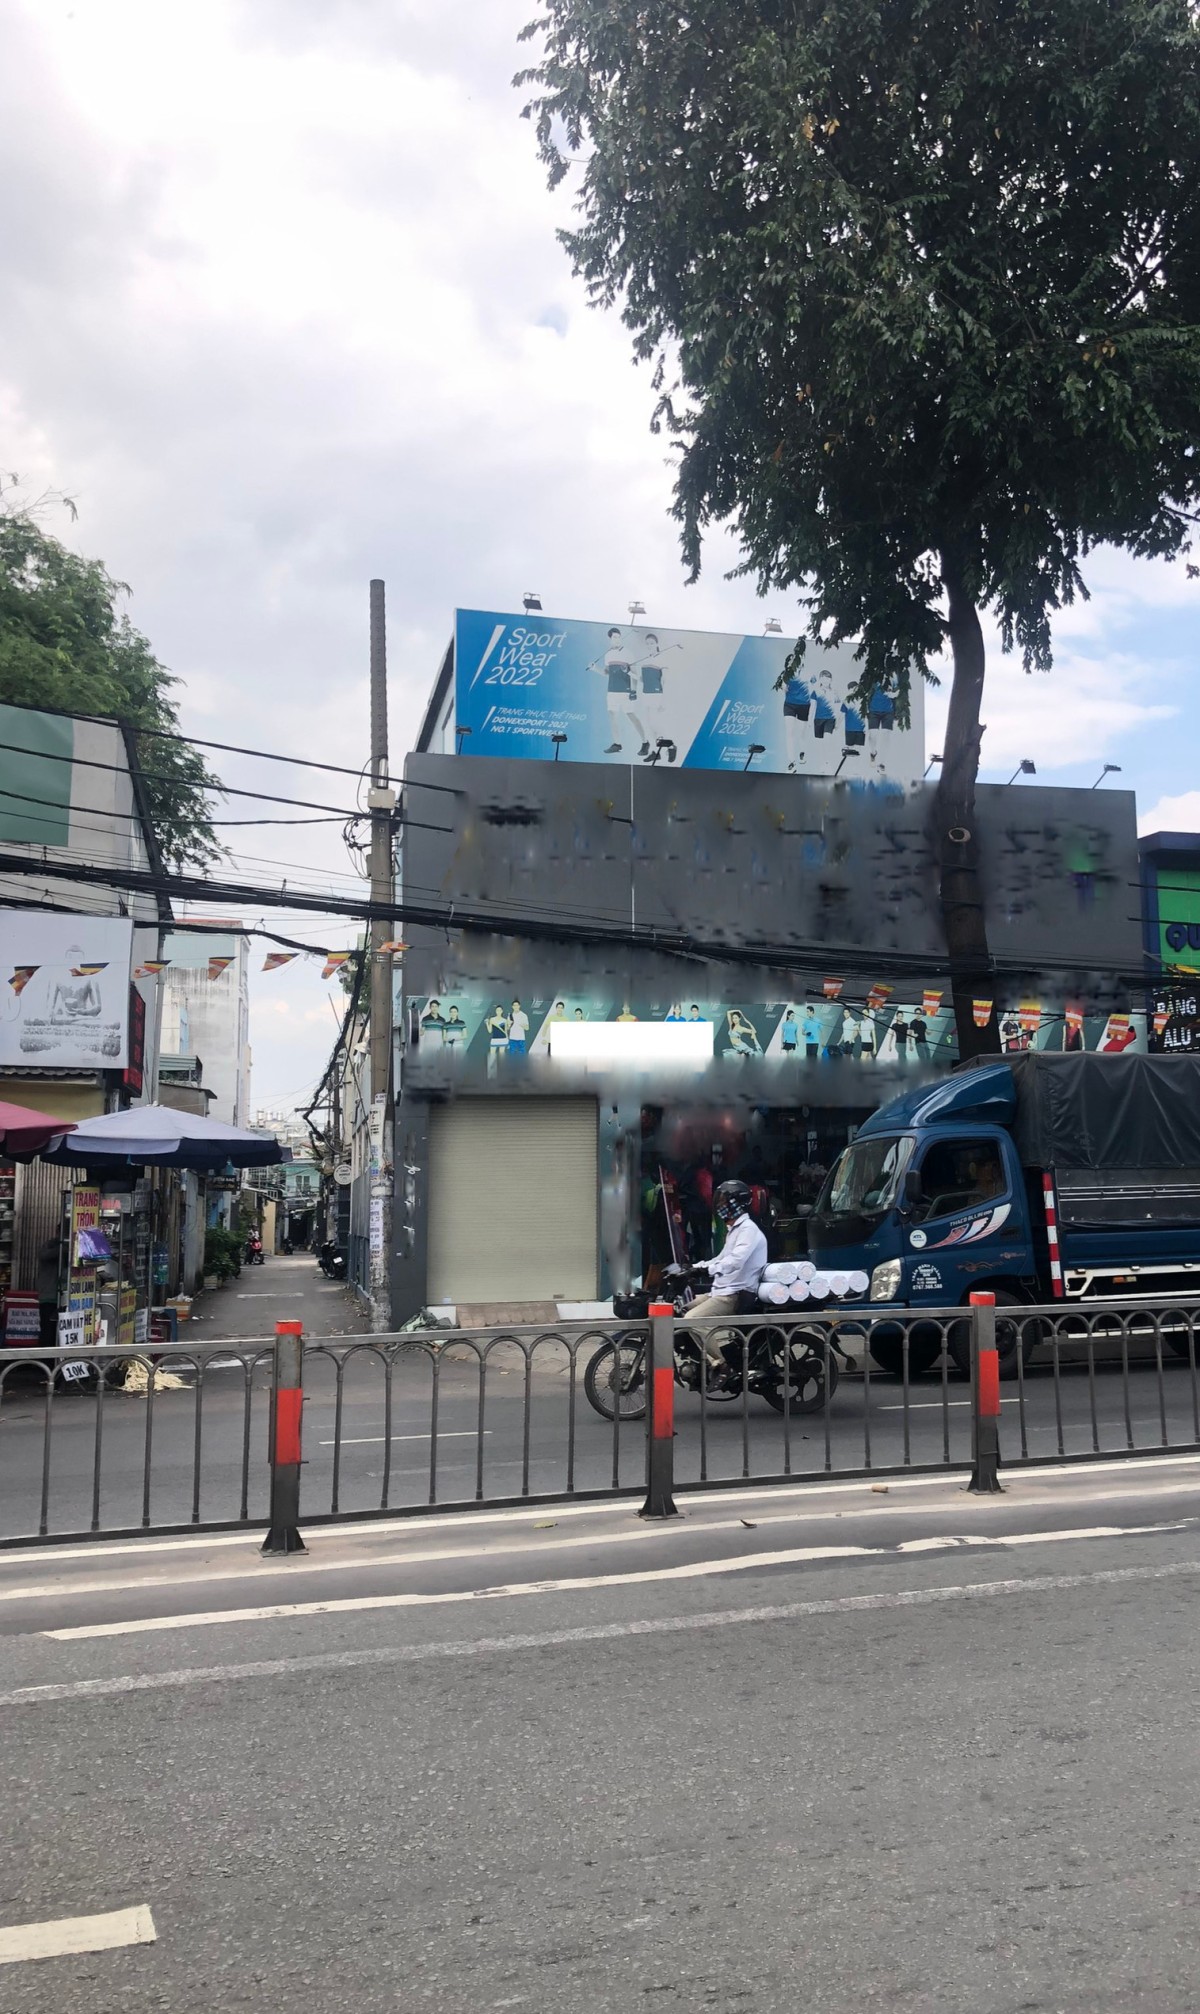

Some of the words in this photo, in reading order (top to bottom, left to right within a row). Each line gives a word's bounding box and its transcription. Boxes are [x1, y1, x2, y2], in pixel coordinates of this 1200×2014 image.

[508, 627, 567, 650] Sport
[499, 647, 557, 667] Wear
[484, 666, 543, 686] 2022
[497, 707, 525, 716] TRANG
[731, 701, 765, 714] Sport
[492, 716, 548, 727] DONEXSPORT
[548, 720, 568, 729] 2022
[726, 712, 758, 724] Wear
[718, 723, 751, 735] 2022
[1163, 1026, 1191, 1048] ALU
[65, 1332, 79, 1345] 15K
[66, 1364, 85, 1378] 10K
